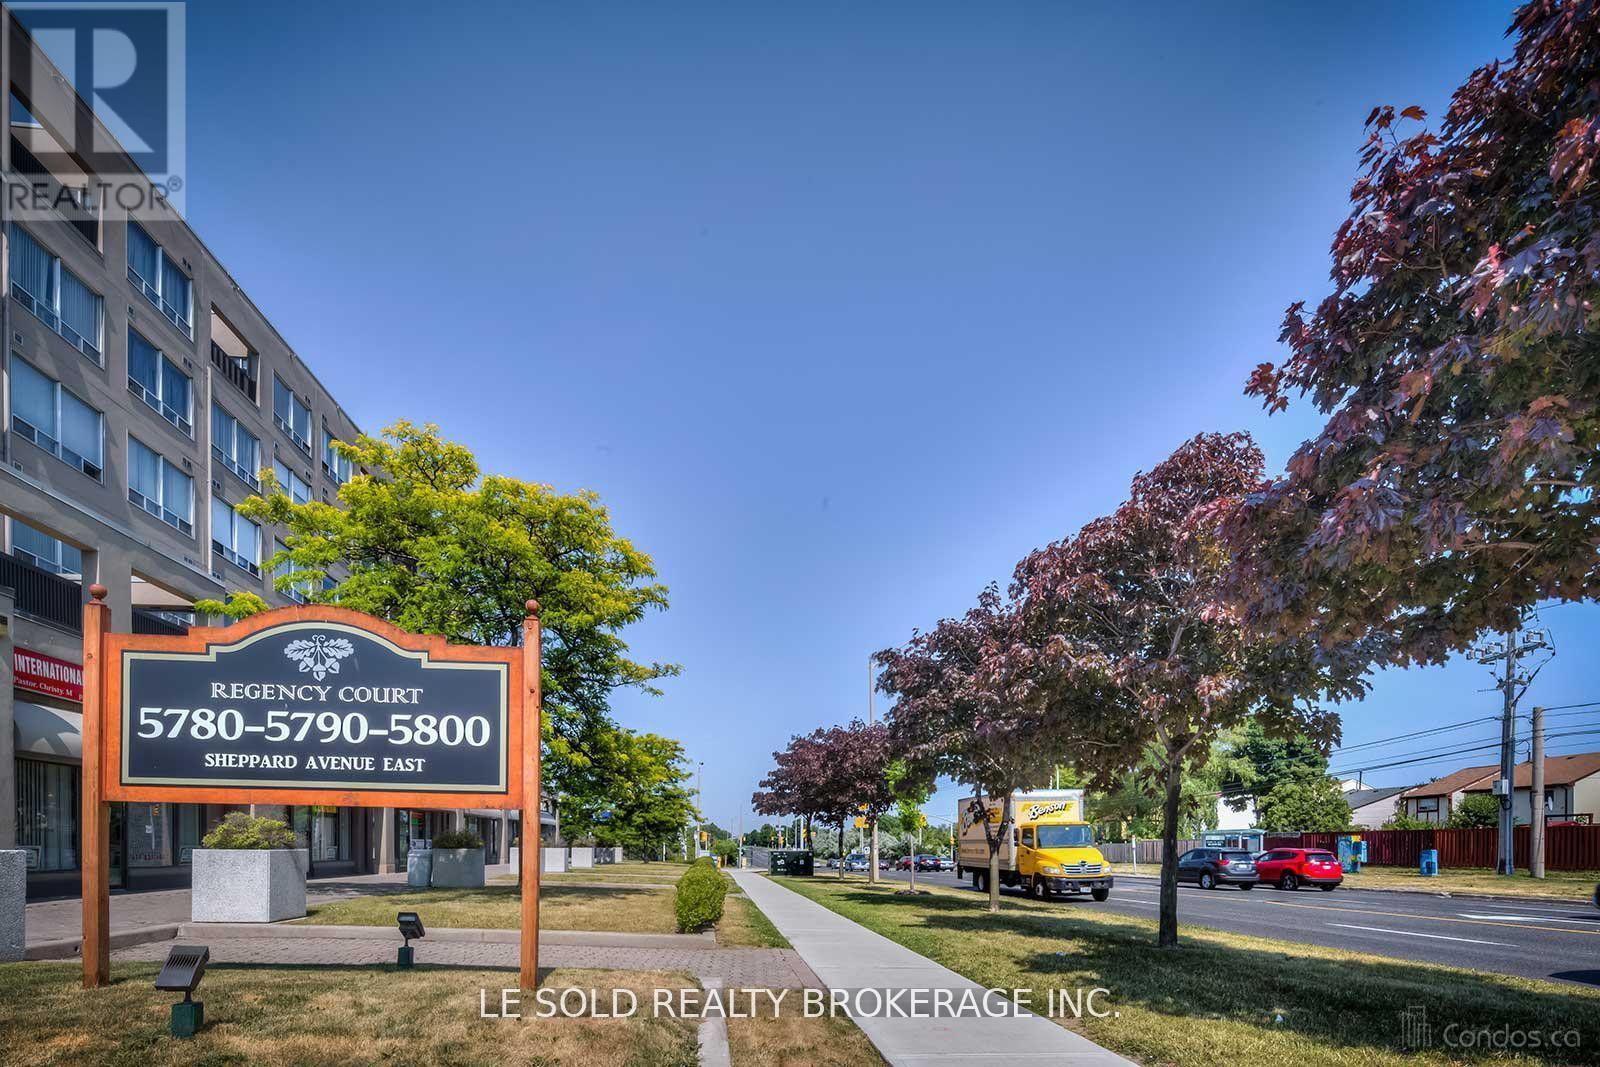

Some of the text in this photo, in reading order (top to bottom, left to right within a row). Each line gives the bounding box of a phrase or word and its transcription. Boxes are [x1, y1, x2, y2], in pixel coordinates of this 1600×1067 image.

[14, 653, 84, 686] INTERNATIONA
[210, 682, 424, 704] REGENCY COURT
[204, 752, 426, 772] SHEPPARD AVENUE EAST
[1027, 801, 1067, 821] Benson
